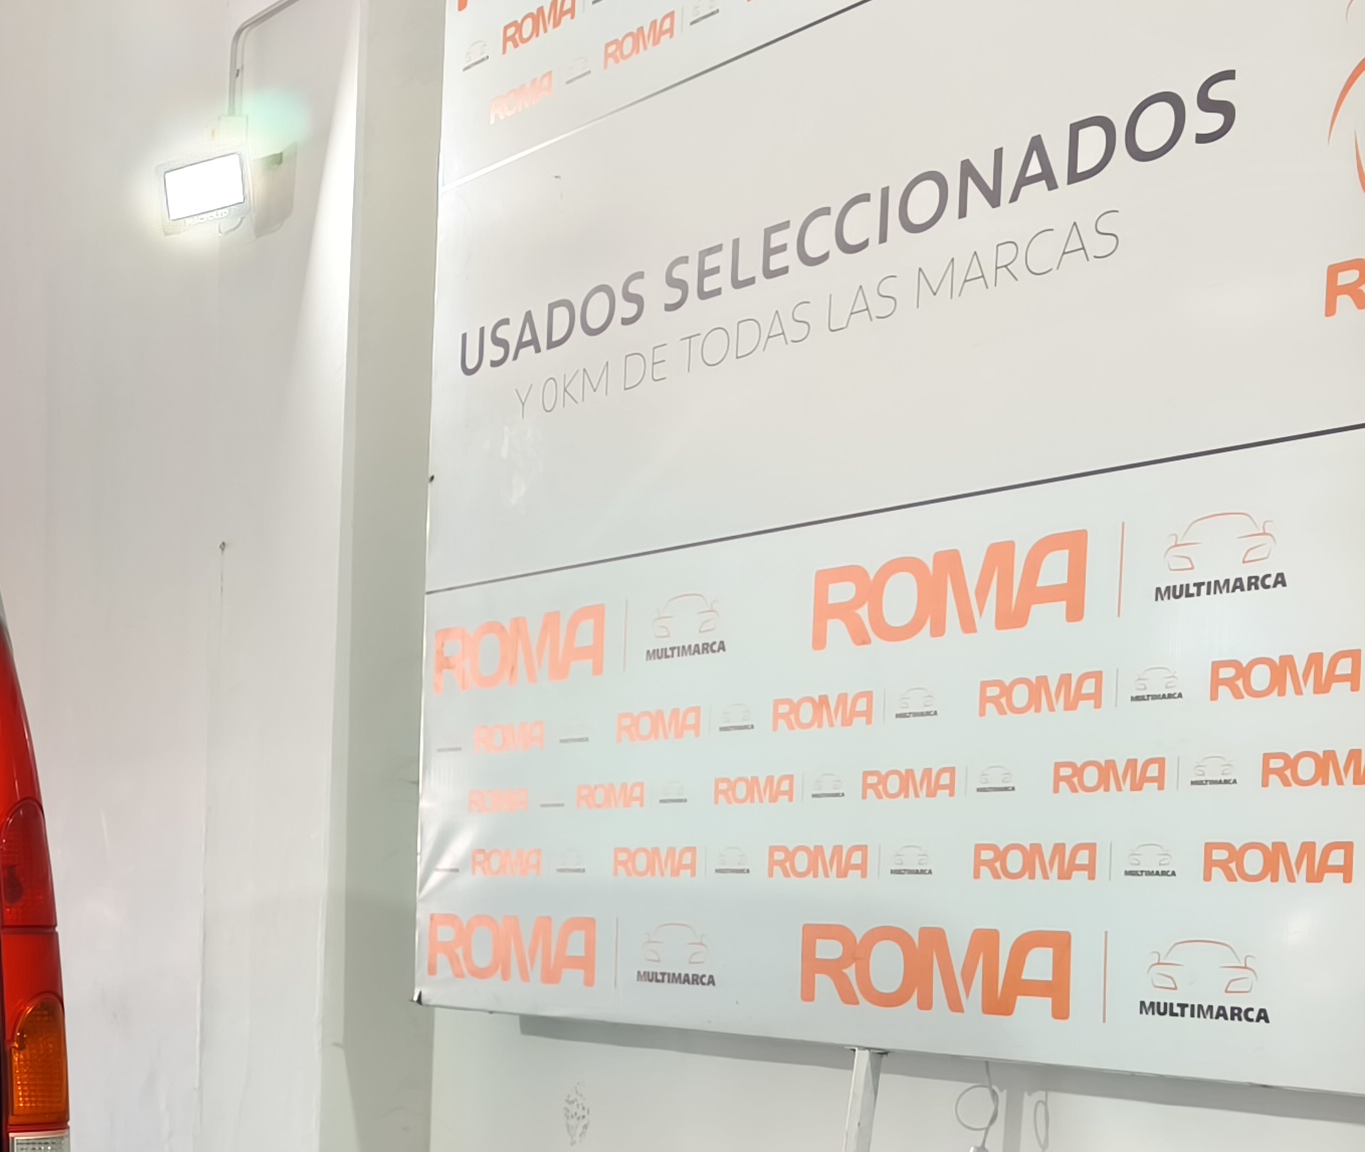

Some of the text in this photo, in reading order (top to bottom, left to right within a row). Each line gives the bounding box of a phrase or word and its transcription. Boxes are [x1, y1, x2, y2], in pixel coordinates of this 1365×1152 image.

[502, 0, 576, 55] ROMA
[603, 10, 676, 70] ROMA
[489, 70, 554, 125] ROMA
[459, 69, 1239, 377] USADOS SELECCIONADOS
[513, 383, 534, 421] Y
[622, 343, 669, 392] DE
[679, 301, 813, 374] TODAS
[826, 273, 900, 335] LAS
[913, 209, 1123, 311] MARCAS
[811, 529, 1287, 651] ROMA MULTIMARCA
[433, 604, 726, 695] ROMA MULTIMARCA
[979, 670, 1103, 717] ROMA
[1210, 649, 1362, 702] ROMA
[616, 706, 701, 744] ROMA
[772, 690, 873, 732] ROMA
[474, 721, 544, 753] ROMA
[714, 774, 795, 805] ROMA
[861, 766, 956, 800] ROMA
[1053, 757, 1167, 794] ROMA
[1261, 748, 1365, 789] ROM
[468, 788, 529, 814] ROMA
[576, 782, 645, 810] ROMA
[471, 848, 542, 878] ROMA
[612, 846, 697, 878] ROMA
[767, 844, 869, 879] ROMA
[972, 842, 1097, 881] ROMA
[1203, 841, 1355, 885] ROMA
[427, 913, 716, 988] ROMA MULTIMARCA
[800, 923, 1271, 1024] ROMA MULTIMARCA
